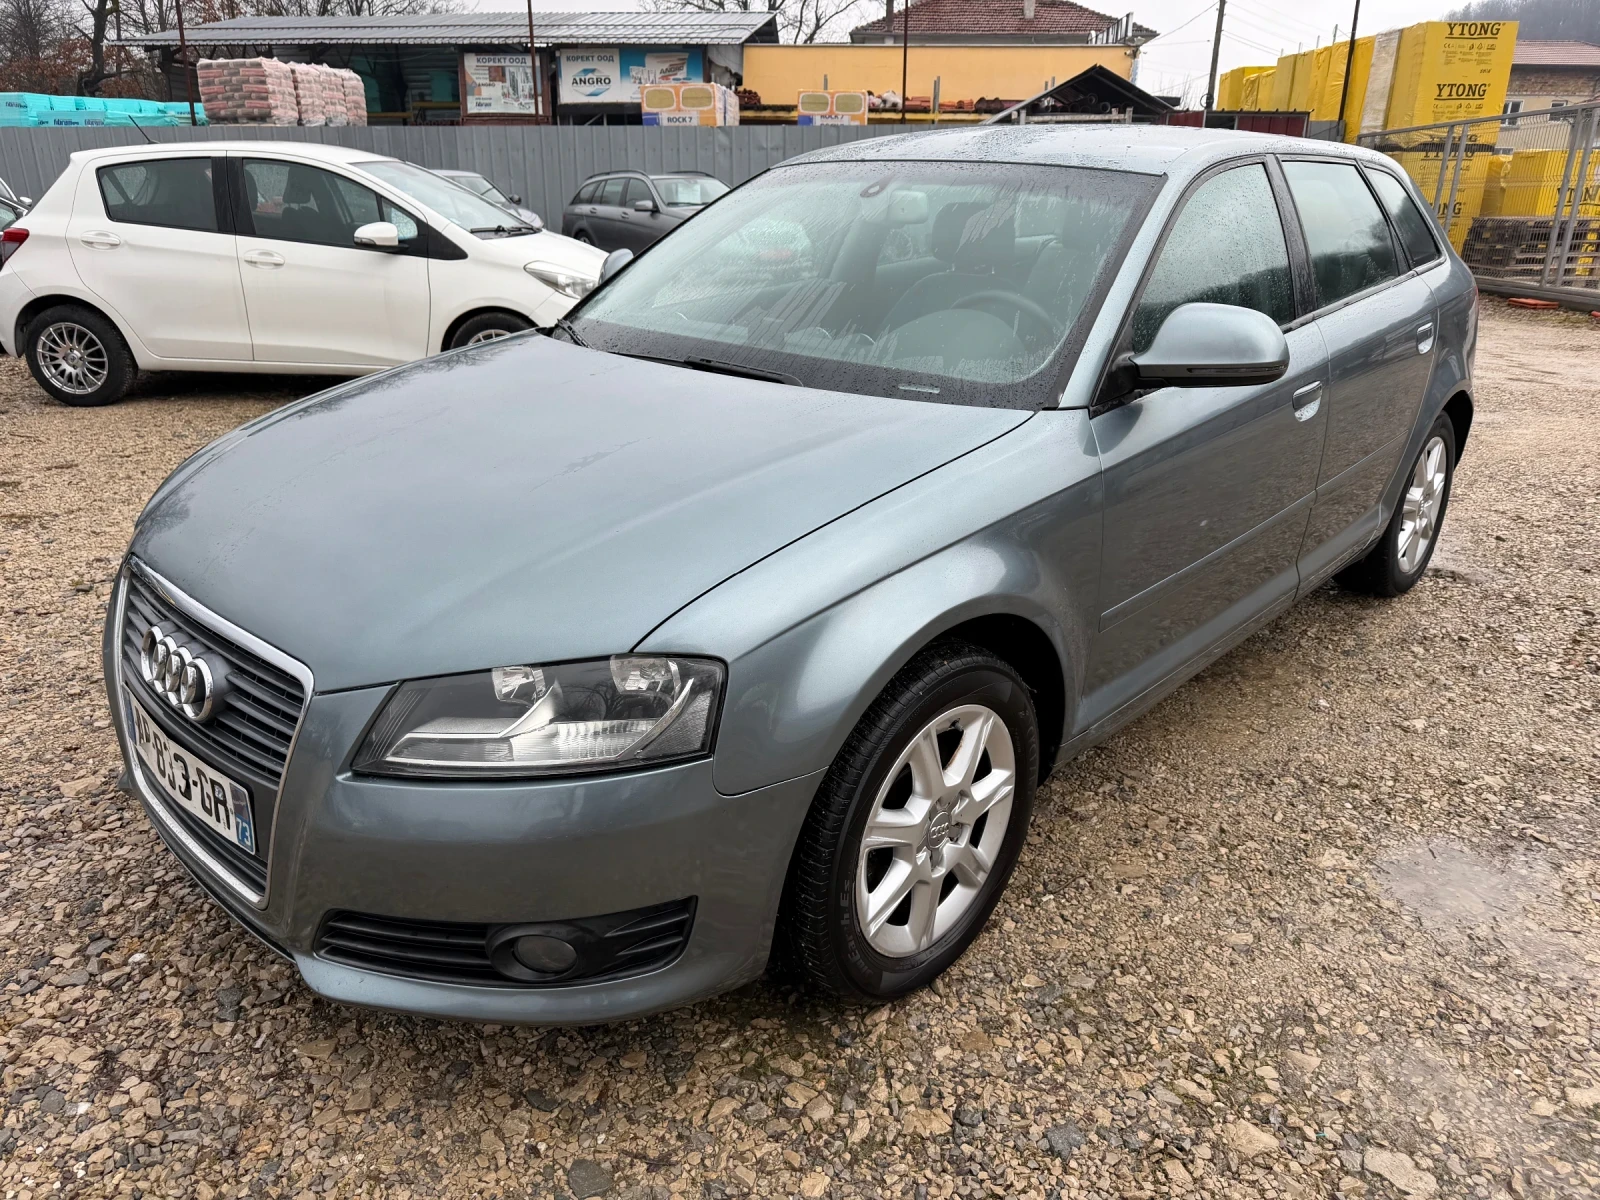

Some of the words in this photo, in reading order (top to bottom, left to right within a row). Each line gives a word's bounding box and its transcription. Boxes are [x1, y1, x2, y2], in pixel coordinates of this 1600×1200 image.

[1447, 22, 1501, 36] YTONG
[509, 57, 527, 65] ООД
[571, 77, 611, 86] ANGRO
[1436, 83, 1487, 97] YTONG
[667, 116, 687, 124] ROCK
[236, 817, 251, 847] 73
